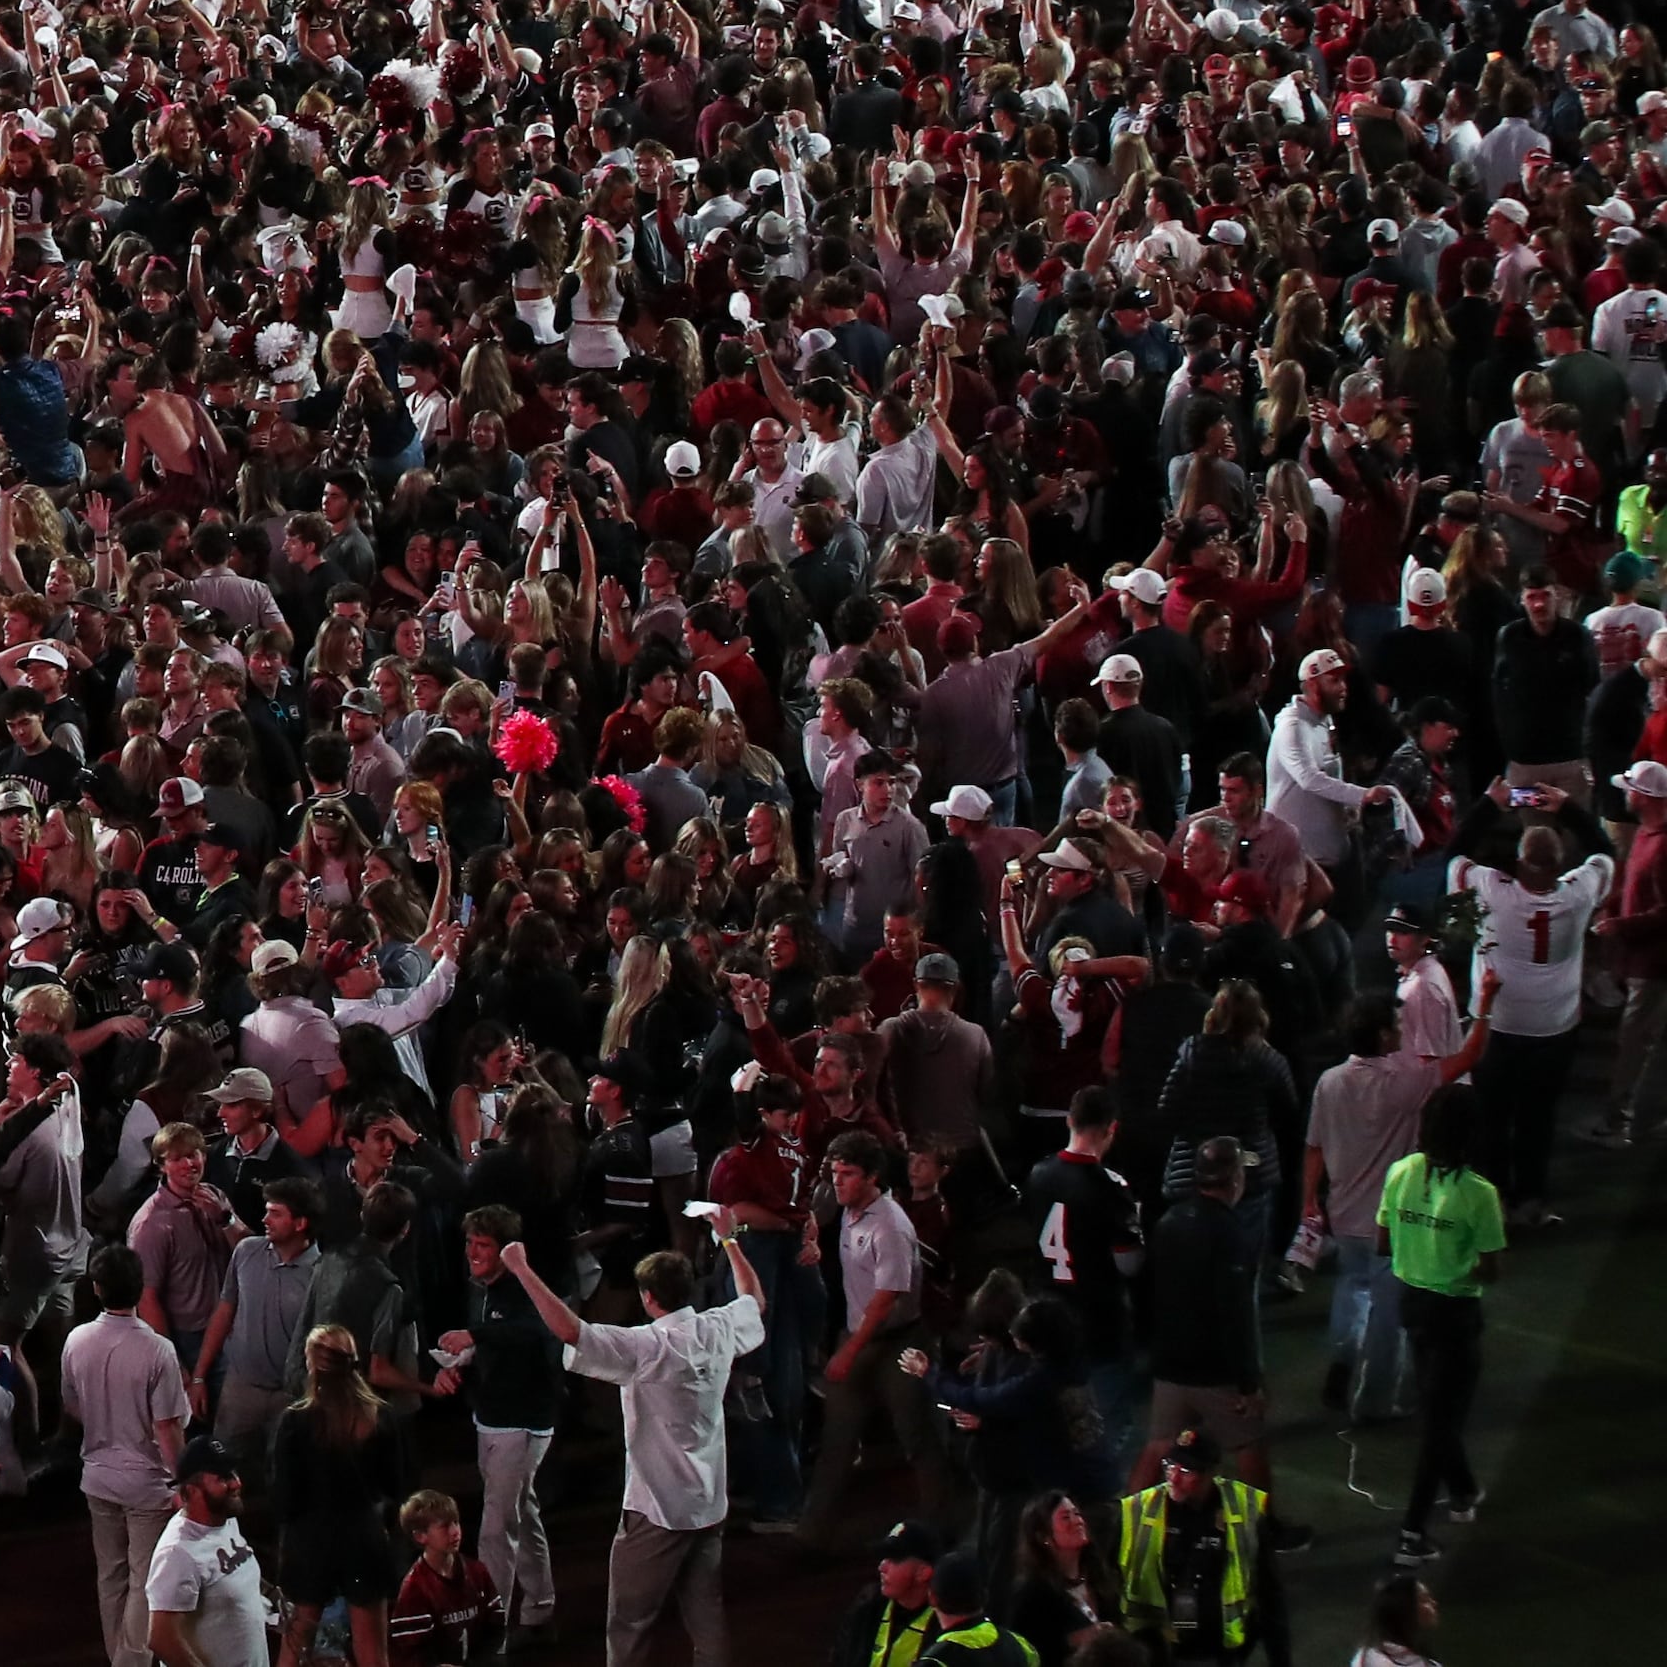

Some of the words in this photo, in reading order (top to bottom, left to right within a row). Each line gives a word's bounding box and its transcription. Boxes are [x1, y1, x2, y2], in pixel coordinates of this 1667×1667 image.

[156, 865, 205, 887] CAROLI
[1527, 910, 1552, 965] 1
[789, 1167, 801, 1208] 1
[1038, 1202, 1074, 1283] 4
[458, 1627, 469, 1661] 1
